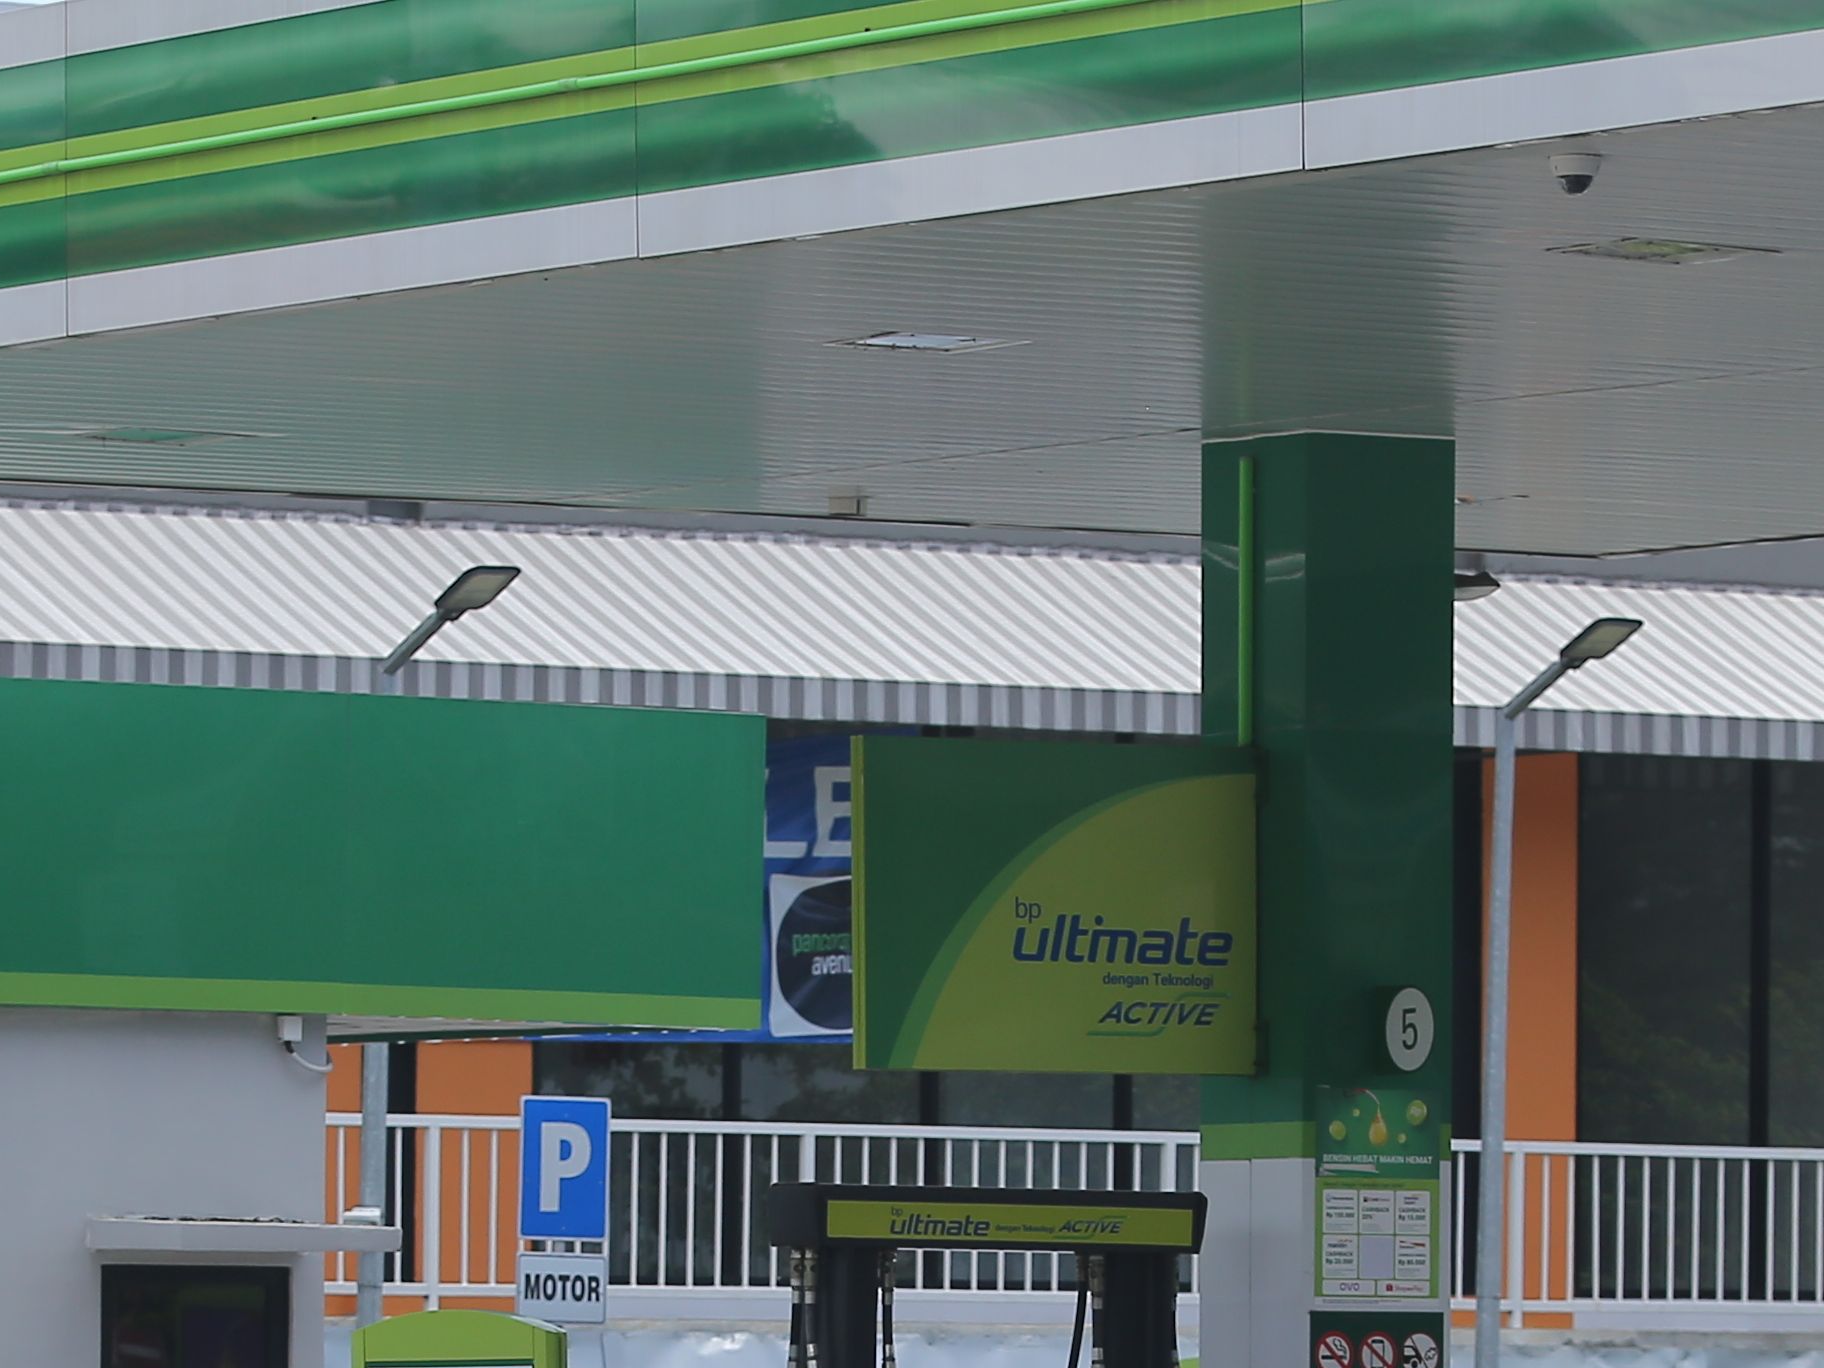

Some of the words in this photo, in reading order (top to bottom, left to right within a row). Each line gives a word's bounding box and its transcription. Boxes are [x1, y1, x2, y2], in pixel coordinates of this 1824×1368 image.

[1015, 896, 1042, 923] bp
[1013, 914, 1233, 966] ultimate
[1103, 972, 1149, 988] dengan
[1153, 973, 1214, 989] Teknologi
[1097, 1001, 1220, 1026] ACTIVE
[1401, 1008, 1418, 1051] 5
[539, 1121, 592, 1213] P
[890, 1213, 990, 1236] ultimate
[1058, 1220, 1123, 1234] ACTIVE
[524, 1273, 600, 1302] MOTOR
